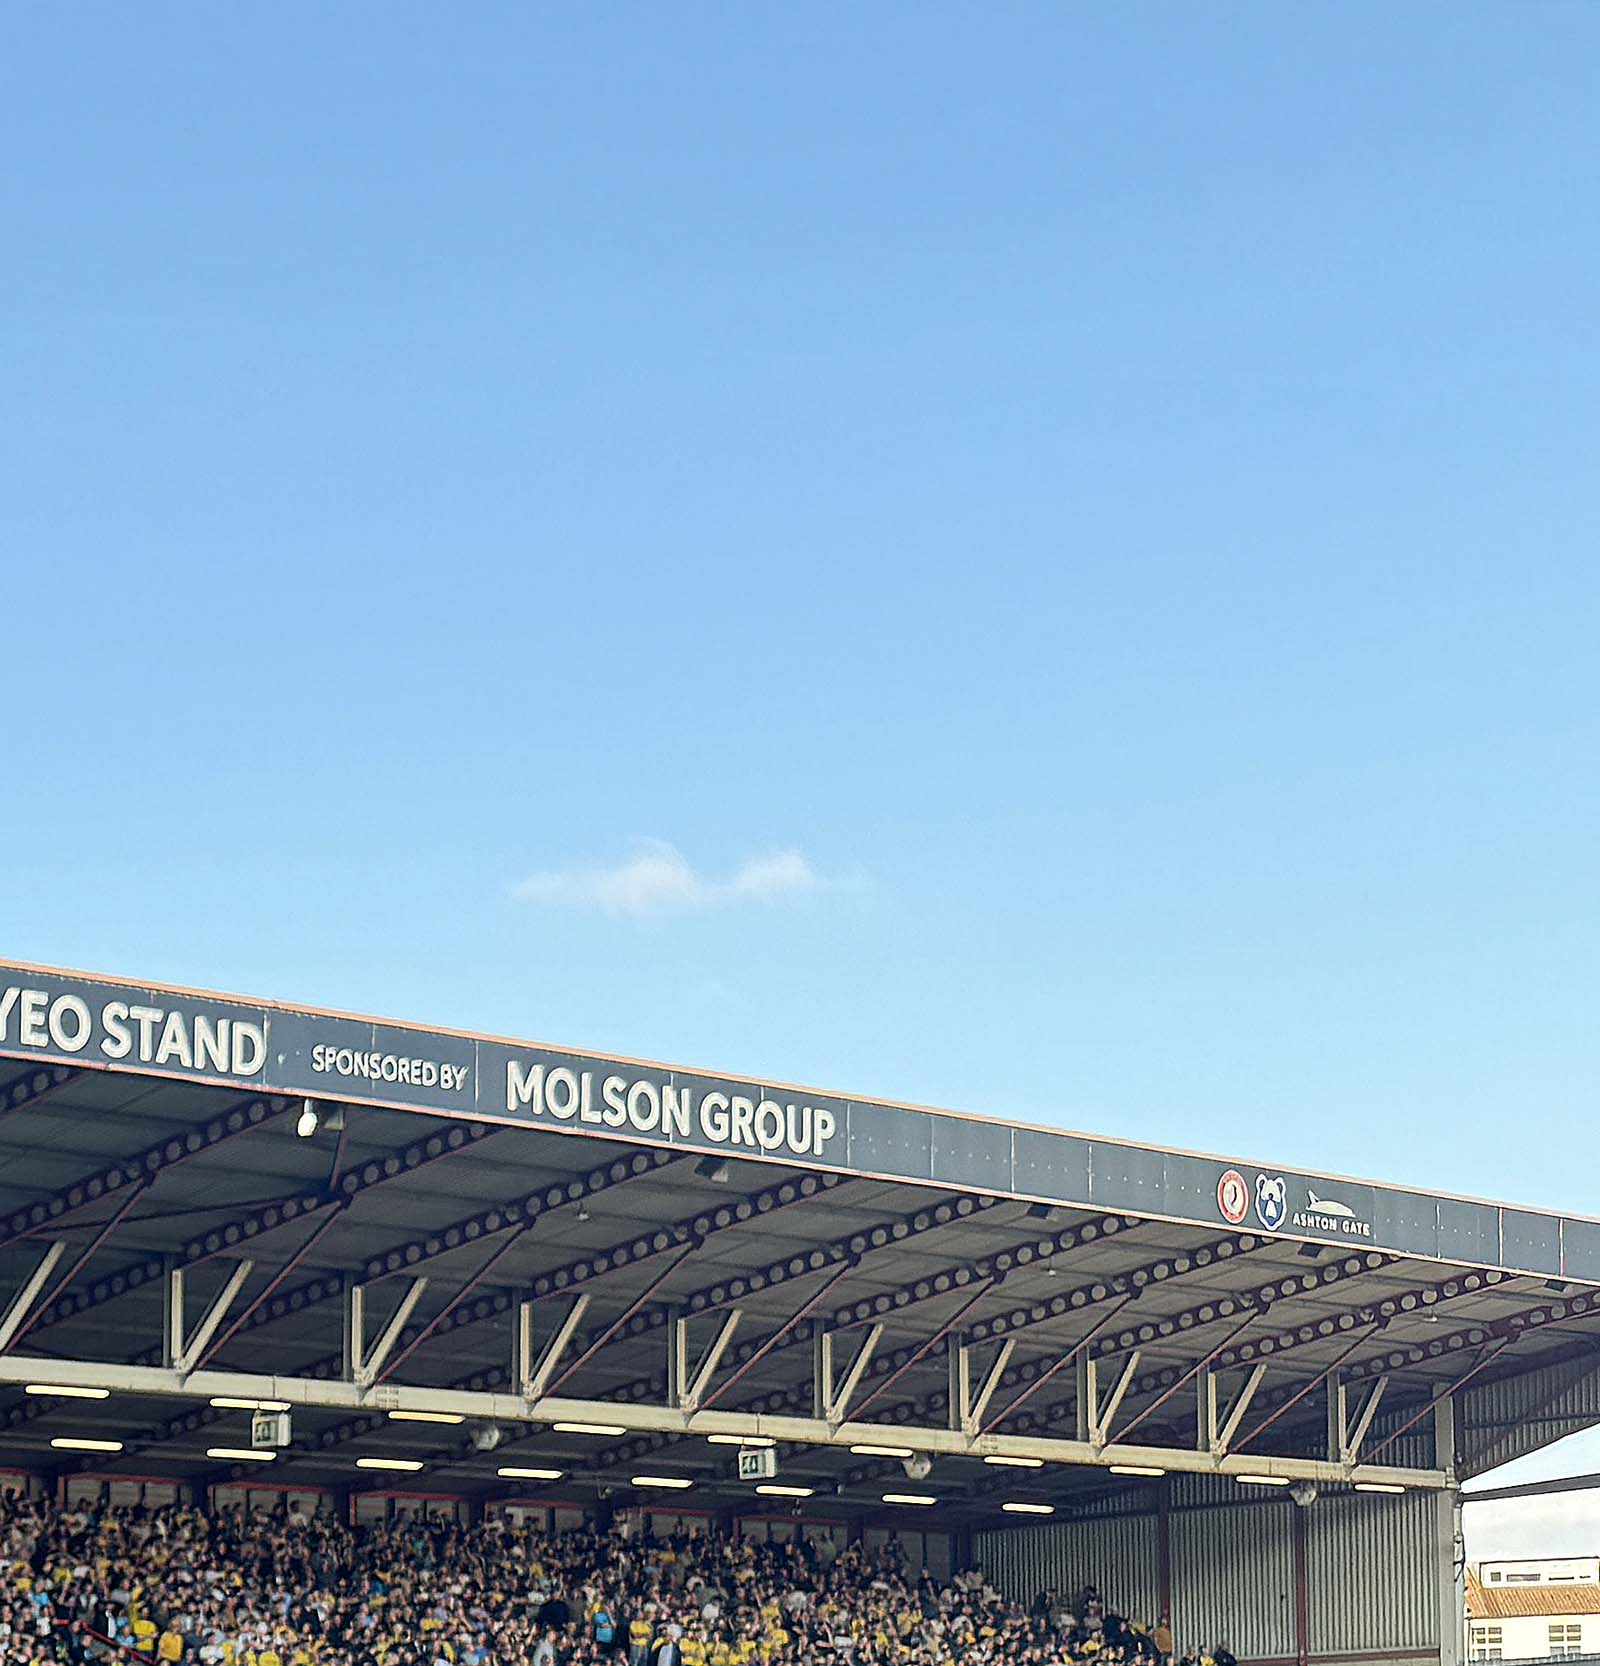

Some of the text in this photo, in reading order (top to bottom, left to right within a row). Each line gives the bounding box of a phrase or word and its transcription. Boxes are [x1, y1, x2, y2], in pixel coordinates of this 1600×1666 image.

[100, 1000, 268, 1076] STAND
[311, 1043, 469, 1092] SPONSORED BY
[505, 1059, 837, 1156] MOLSON GROUP
[1292, 1212, 1372, 1237] ASHTON GATE
